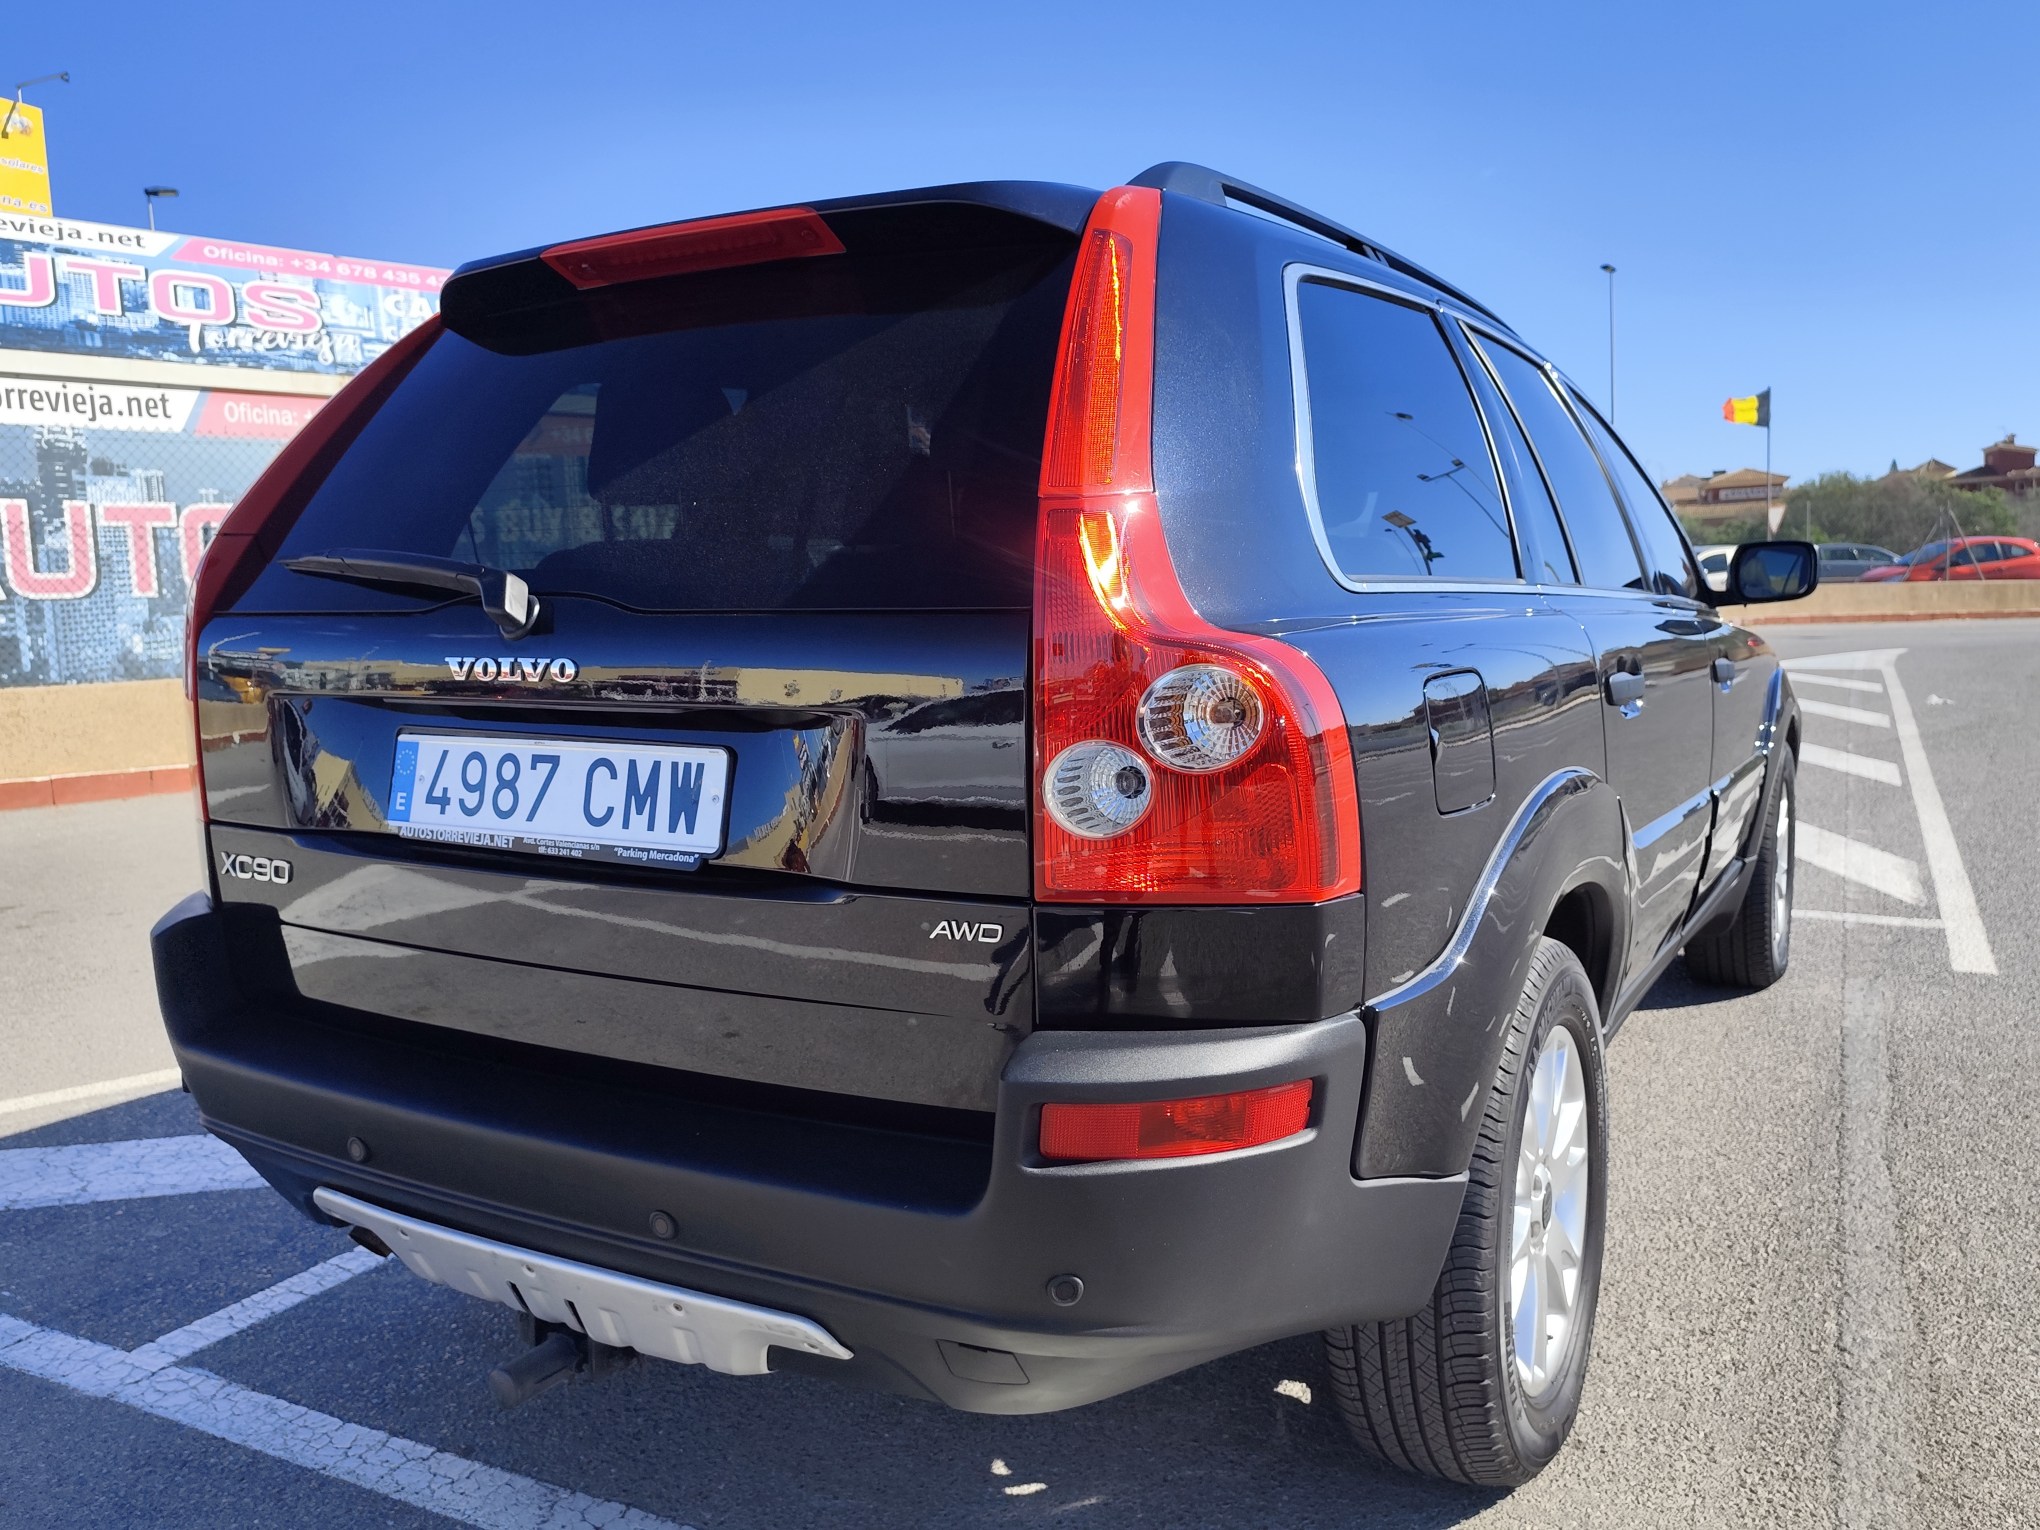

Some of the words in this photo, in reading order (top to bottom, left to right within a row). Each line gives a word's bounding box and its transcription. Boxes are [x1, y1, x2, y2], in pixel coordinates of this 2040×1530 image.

[203, 245, 284, 267] Oficina:
[290, 257, 332, 274] +34
[336, 262, 378, 280] 678
[382, 268, 421, 286] 435
[0, 383, 172, 421] rrevieja.net
[223, 400, 299, 427] Oficina:
[445, 656, 577, 684] VOLVO
[395, 792, 406, 811] E
[424, 749, 561, 822] 4987
[583, 756, 705, 835] CMW
[400, 825, 515, 849] AUTOSTORREVIEJA.NET
[556, 839, 590, 850] Valencianas
[221, 851, 291, 885] XC90
[929, 920, 1004, 944] AWD
